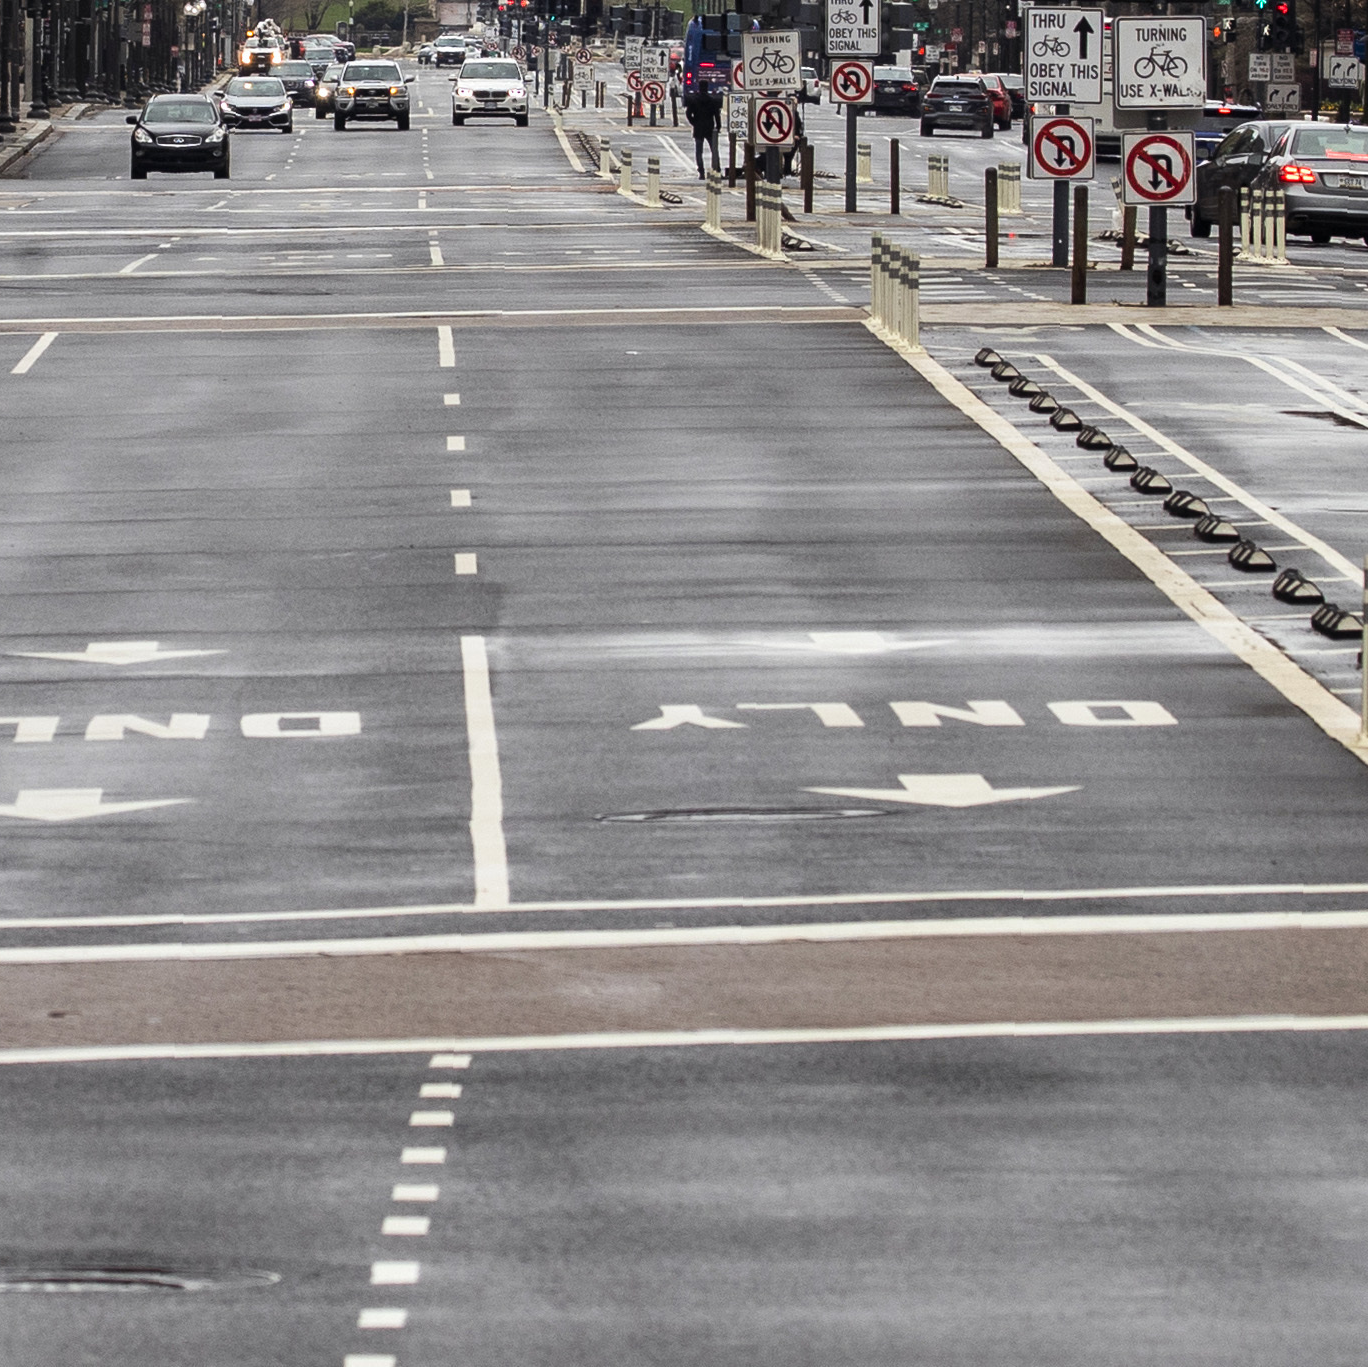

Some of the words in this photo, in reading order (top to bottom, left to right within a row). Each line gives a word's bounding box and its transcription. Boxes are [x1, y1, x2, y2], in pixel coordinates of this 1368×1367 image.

[1031, 13, 1066, 29] THRU
[751, 35, 791, 44] TURNING
[829, 27, 853, 39] OBEY
[857, 27, 877, 39] THIS
[1135, 27, 1187, 42] TURNING
[829, 40, 862, 51] SIGNAL
[1029, 63, 1065, 78] OBEY
[1070, 63, 1099, 80] THIS
[749, 78, 763, 87] USE
[765, 77, 797, 86] X-WALKS
[1029, 81, 1076, 97] SIGNAL
[1120, 84, 1144, 98] USE
[1149, 83, 1202, 98] X-WAL
[630, 699, 1180, 731] ONLY
